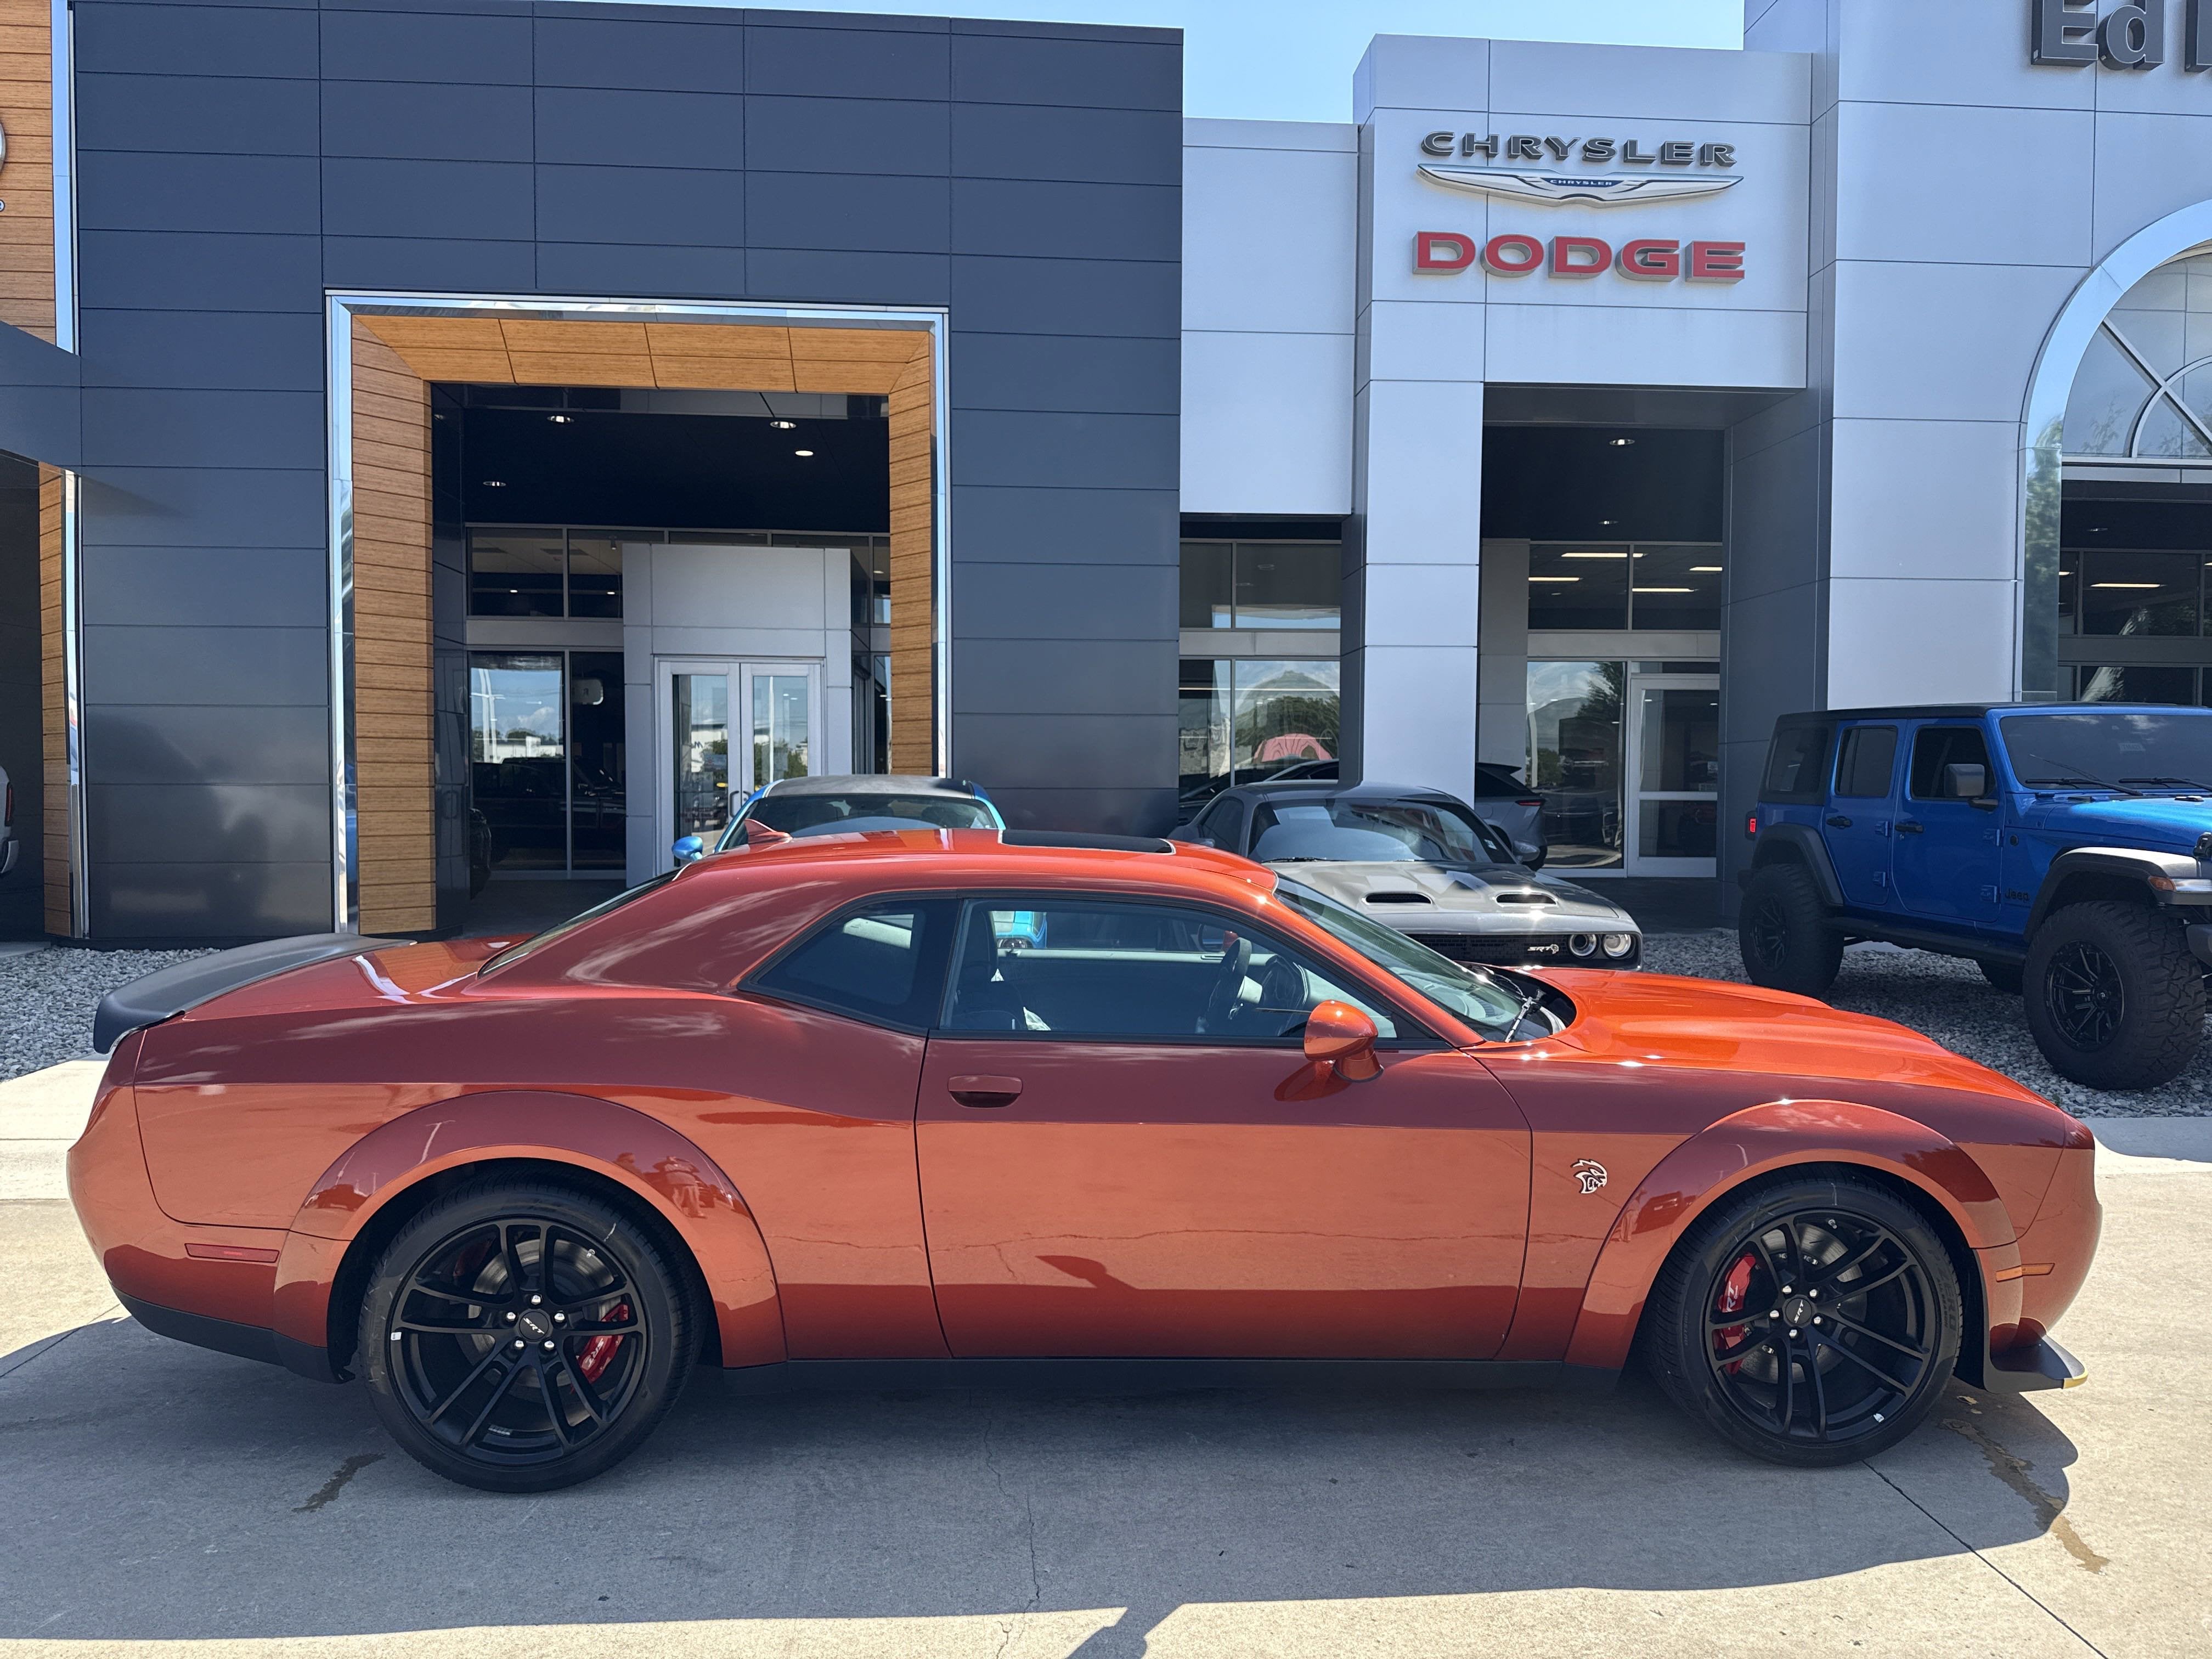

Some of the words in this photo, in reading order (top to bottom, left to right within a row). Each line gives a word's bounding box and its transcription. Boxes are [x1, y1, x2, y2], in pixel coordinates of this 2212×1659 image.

[2031, 0, 2165, 70] Ed
[1421, 131, 1737, 166] CHRYSLER
[1413, 231, 1746, 284] DODGE
[2005, 888, 2030, 904] Jeep
[523, 1317, 545, 1334] SRT
[1794, 1300, 1804, 1324] SRT
[588, 1338, 604, 1368] SRT
